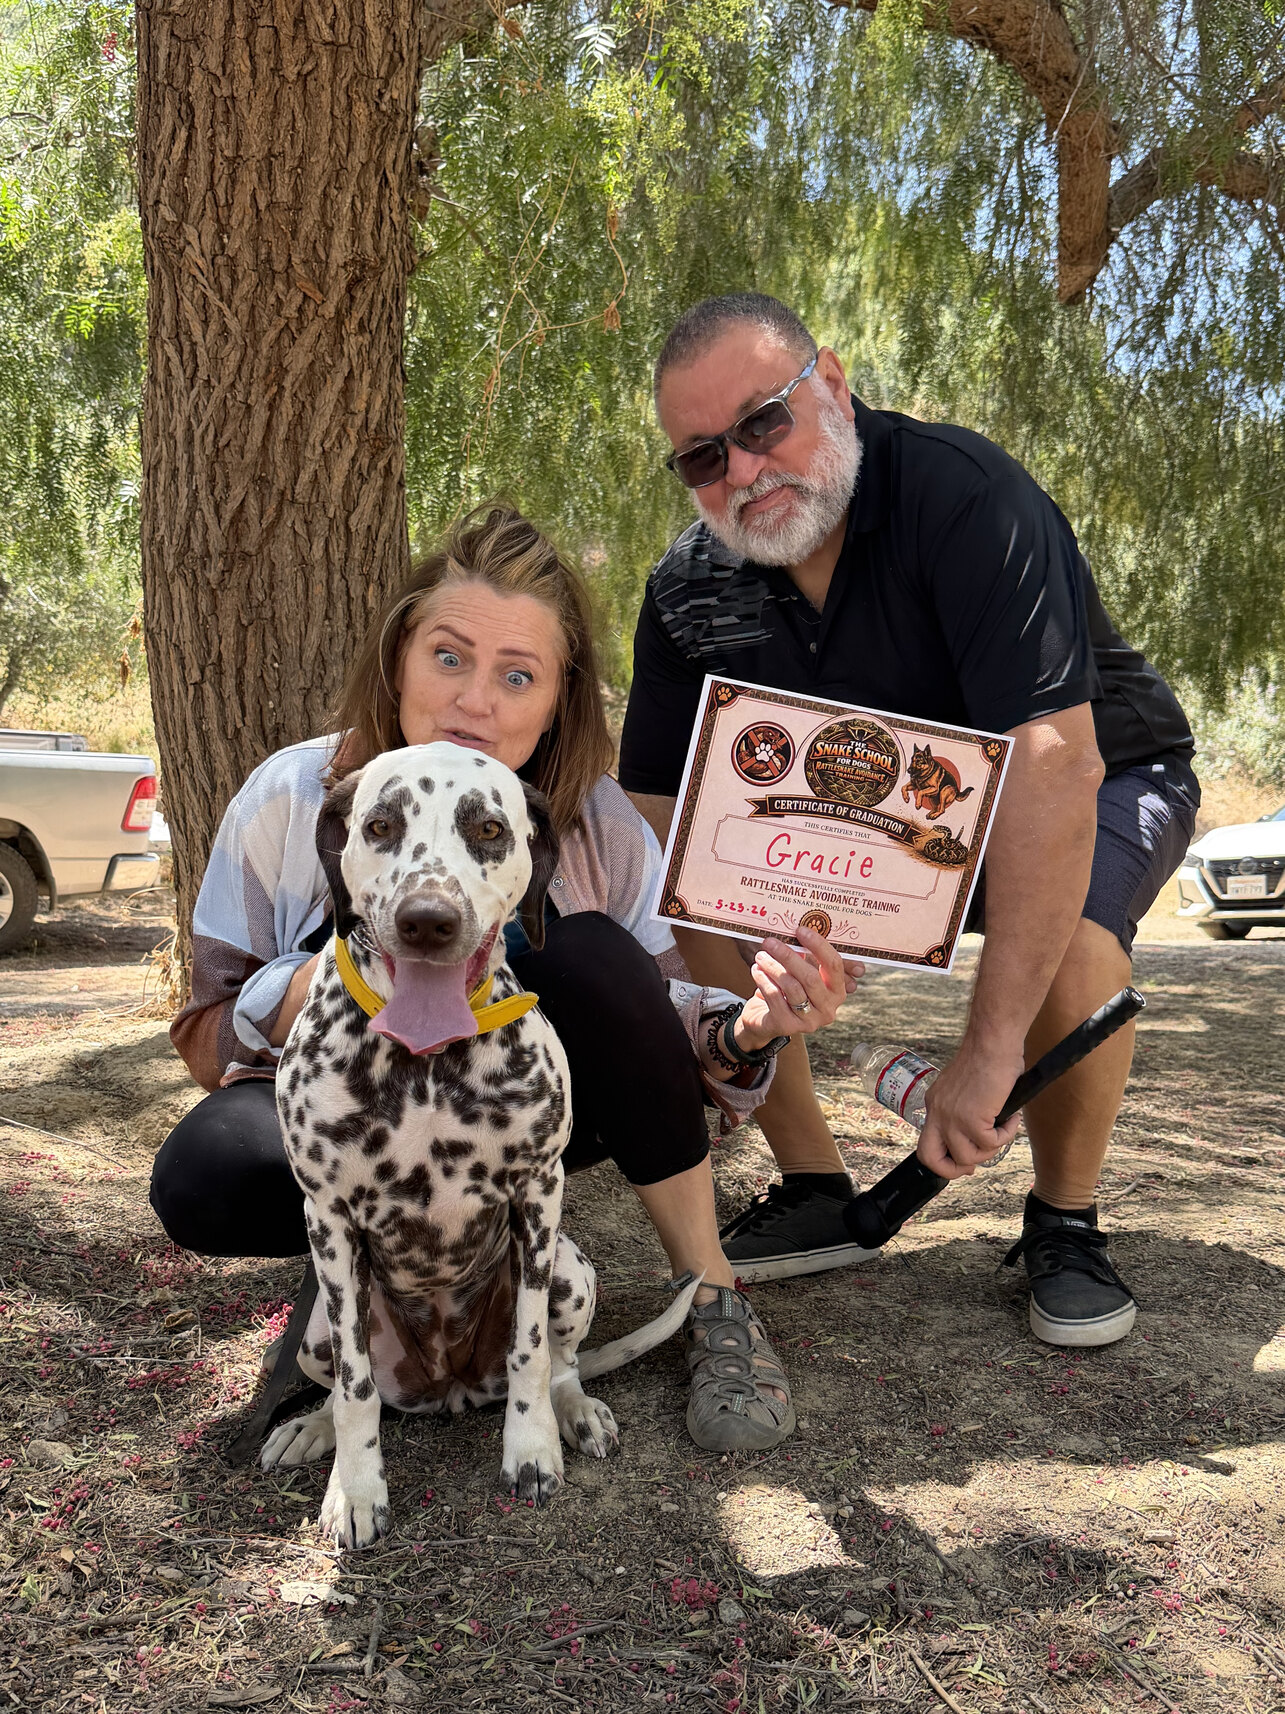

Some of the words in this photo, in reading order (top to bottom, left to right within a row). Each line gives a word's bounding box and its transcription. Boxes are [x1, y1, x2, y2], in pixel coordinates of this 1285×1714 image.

[850, 740, 867, 748] THE
[814, 742, 854, 757] SNAKE
[853, 748, 894, 771] SCHOOL
[852, 760, 872, 770] DOGS
[816, 762, 854, 774] RATTLESNAKE
[855, 768, 886, 782] AVOIDANCE
[836, 772, 864, 782] TRAINING
[774, 800, 834, 814] CERTIFICATE
[836, 806, 848, 816] OF
[850, 808, 904, 834] GRADUATION
[804, 822, 820, 830] THIS
[820, 825, 853, 836] CERTIFIES
[854, 831, 872, 839] THAT
[766, 833, 873, 878] Gracie
[740, 876, 808, 898] RATTLESNAKE
[809, 890, 860, 906] AVOIDANCE
[862, 898, 900, 913] TRAINING
[794, 880, 834, 892] SUCCESSFULLY
[834, 888, 866, 897] COMPLETED
[697, 899, 713, 908] DATE:
[792, 899, 814, 908] SNAKE
[816, 902, 840, 912] SCHOOL
